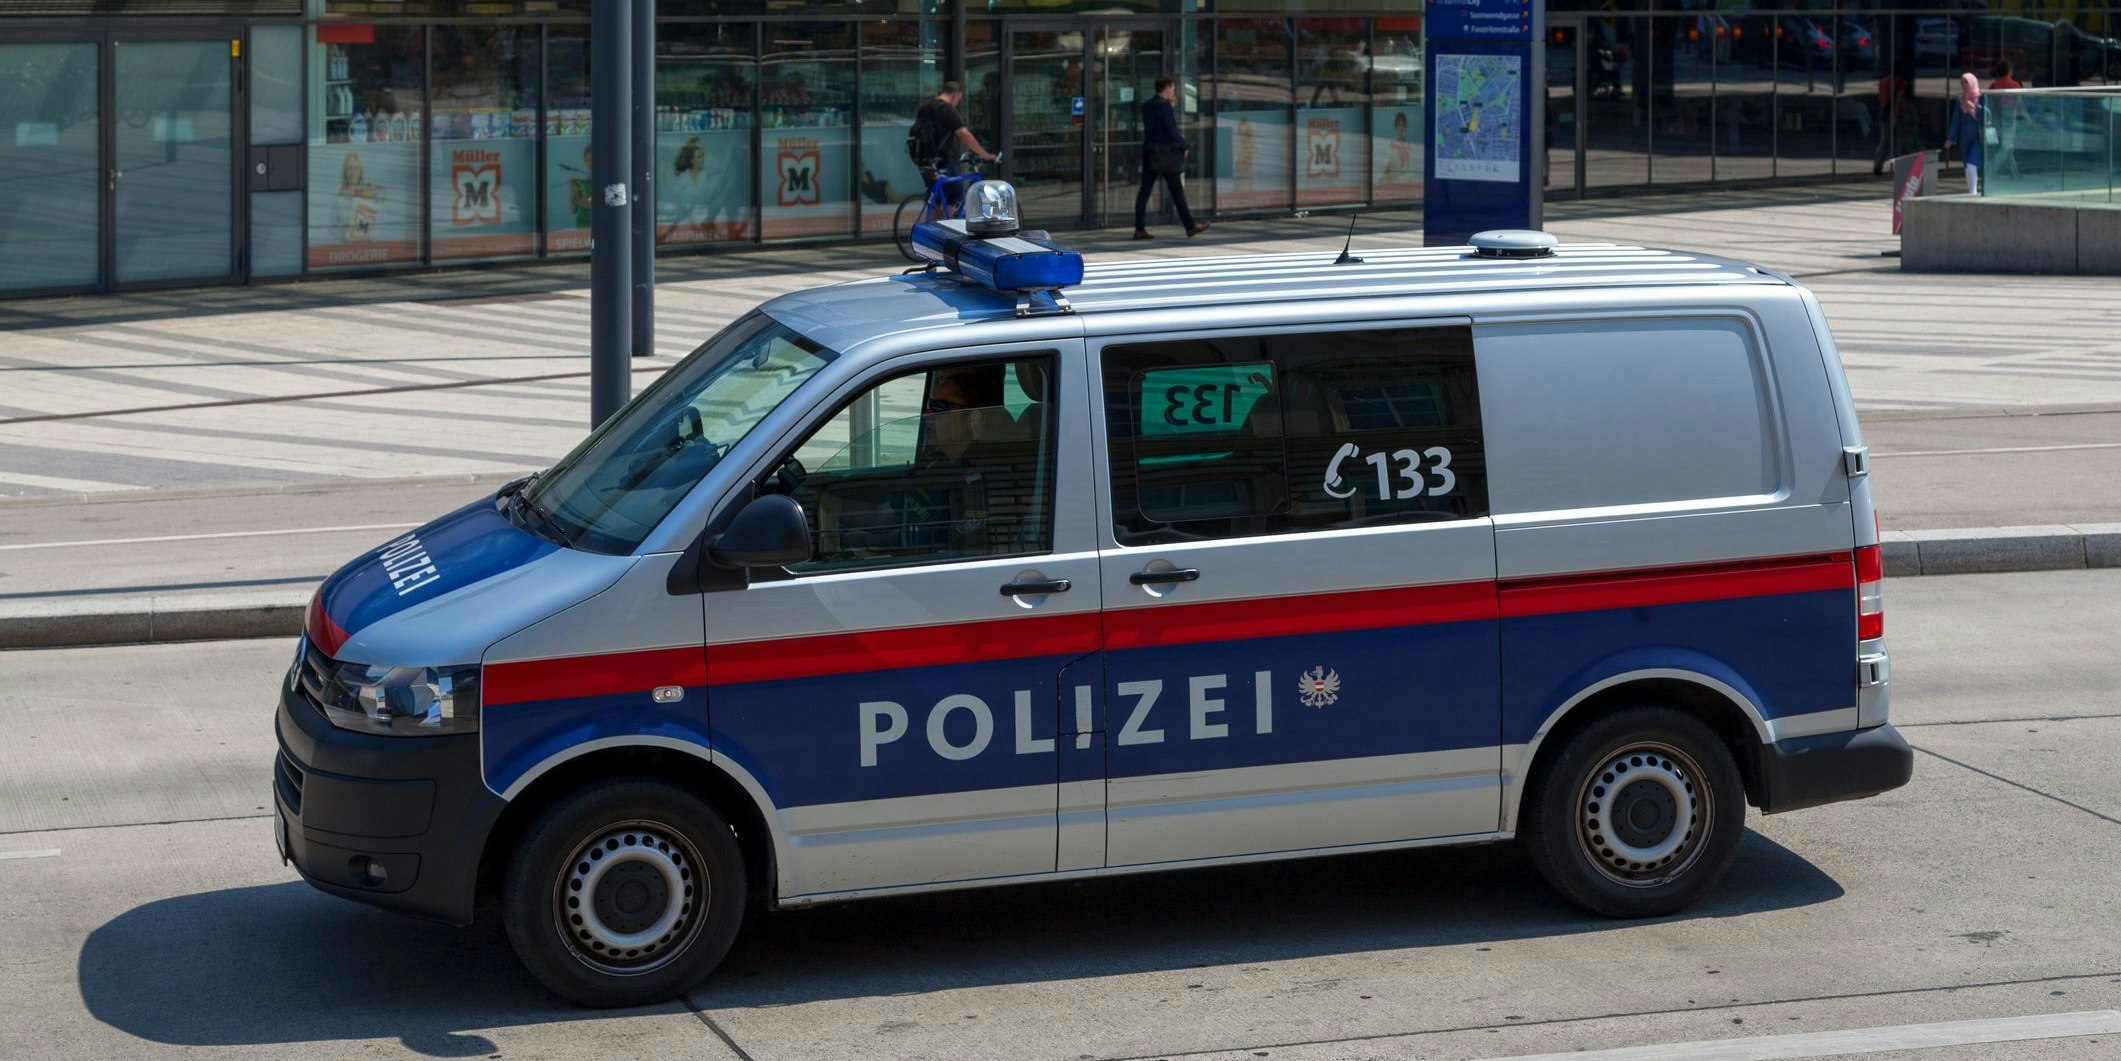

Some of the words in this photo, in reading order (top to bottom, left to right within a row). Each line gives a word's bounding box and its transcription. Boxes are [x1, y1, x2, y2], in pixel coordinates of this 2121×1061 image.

[1470, 11, 1520, 21] Sonnwendgasse
[1471, 25, 1520, 34] Favoritenstraße
[777, 137, 819, 150] Müller
[453, 149, 500, 163] Müller
[1314, 144, 1332, 165] M
[787, 167, 810, 191] M
[464, 181, 489, 208] M
[329, 248, 389, 263] DROGERIE
[1366, 446, 1456, 500] 133
[377, 533, 440, 596] POLIZEI
[859, 670, 1272, 767] POLIZEI
